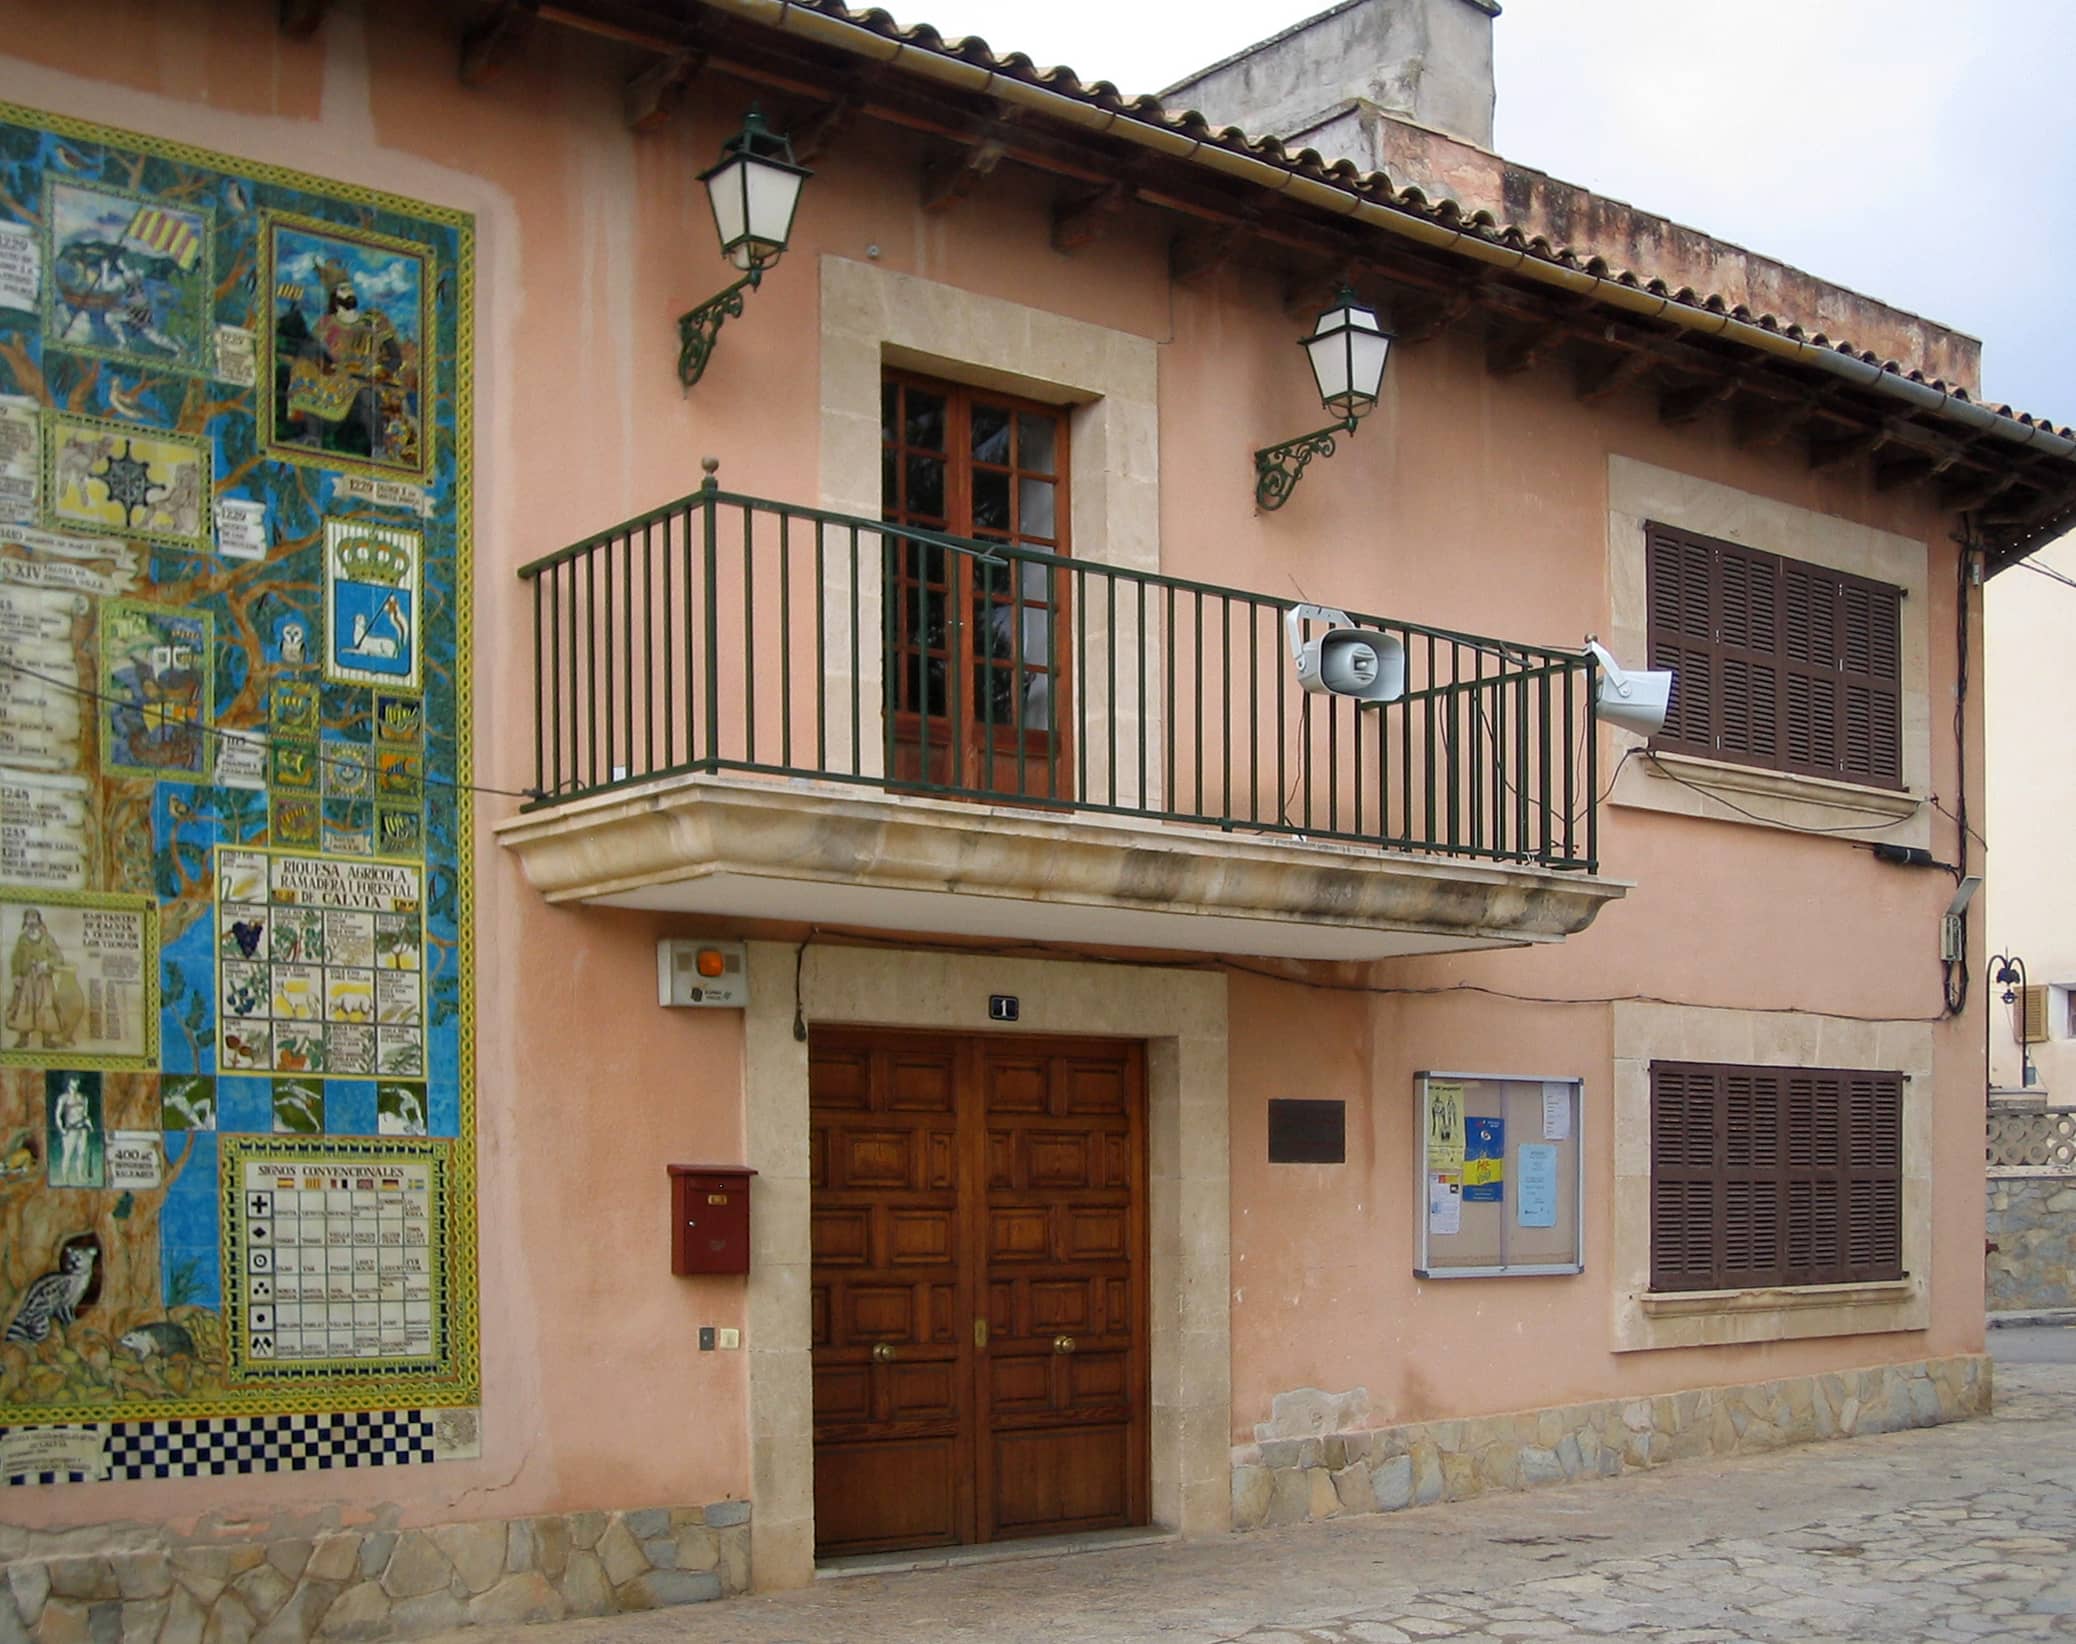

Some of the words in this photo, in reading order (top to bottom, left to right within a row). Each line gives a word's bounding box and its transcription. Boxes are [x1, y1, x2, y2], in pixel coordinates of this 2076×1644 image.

[280, 874, 346, 894] RAMADERA
[355, 880, 413, 898] FORESTAL
[301, 891, 314, 903] DE
[1000, 999, 1008, 1017] 1
[115, 1149, 140, 1161] 400
[258, 1165, 296, 1176] SIGNOS
[302, 1166, 404, 1178] CONVENCIONALES
